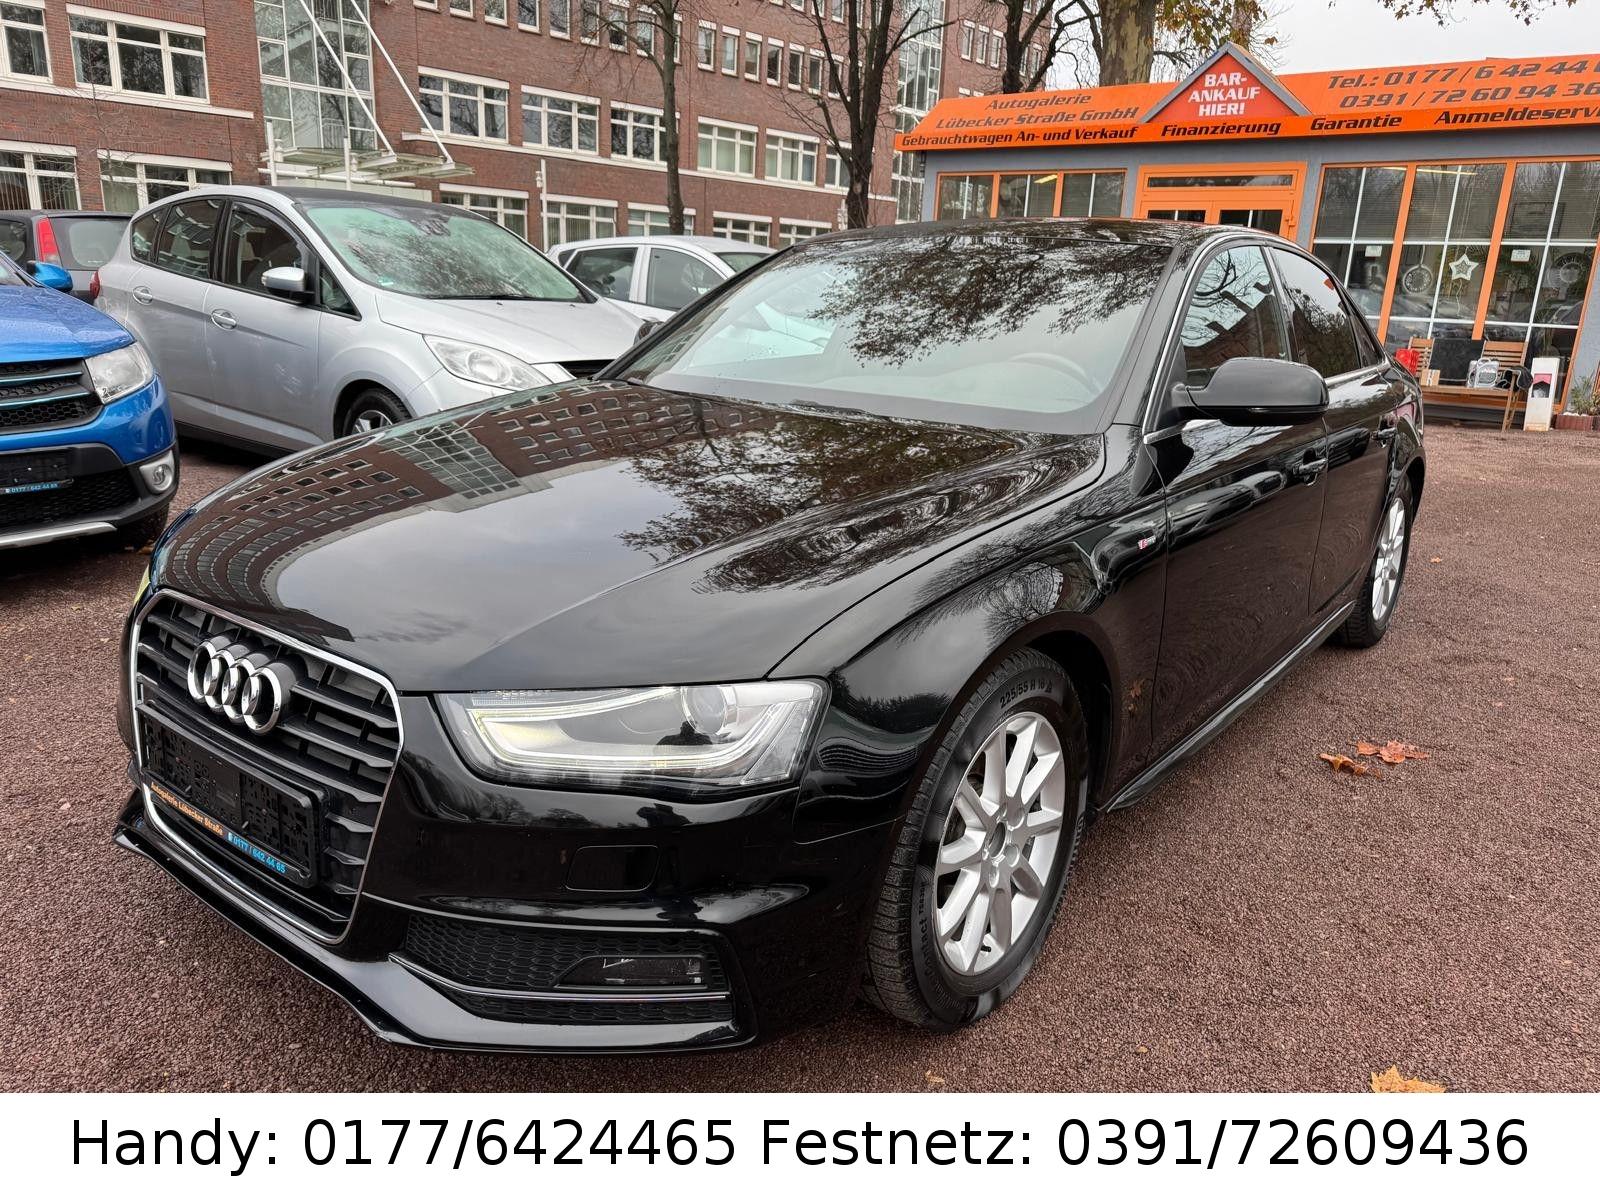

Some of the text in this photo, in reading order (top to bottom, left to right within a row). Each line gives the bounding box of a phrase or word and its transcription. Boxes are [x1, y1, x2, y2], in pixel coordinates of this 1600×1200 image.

[1205, 72, 1248, 87] BAR-
[1328, 74, 1380, 89] Tel.:
[985, 94, 1092, 110] Autogalerie
[1188, 86, 1260, 103] ANKAUF
[1340, 92, 1408, 109] 0391
[1515, 84, 1557, 99] 94
[1199, 102, 1245, 116] HIER!
[936, 106, 1140, 129] Lübecker Straße GmbH
[1311, 114, 1402, 131] Garantie
[902, 126, 1139, 146] Gebrauchtwagen An- und Verkauf
[1161, 122, 1281, 137] Finanzierung
